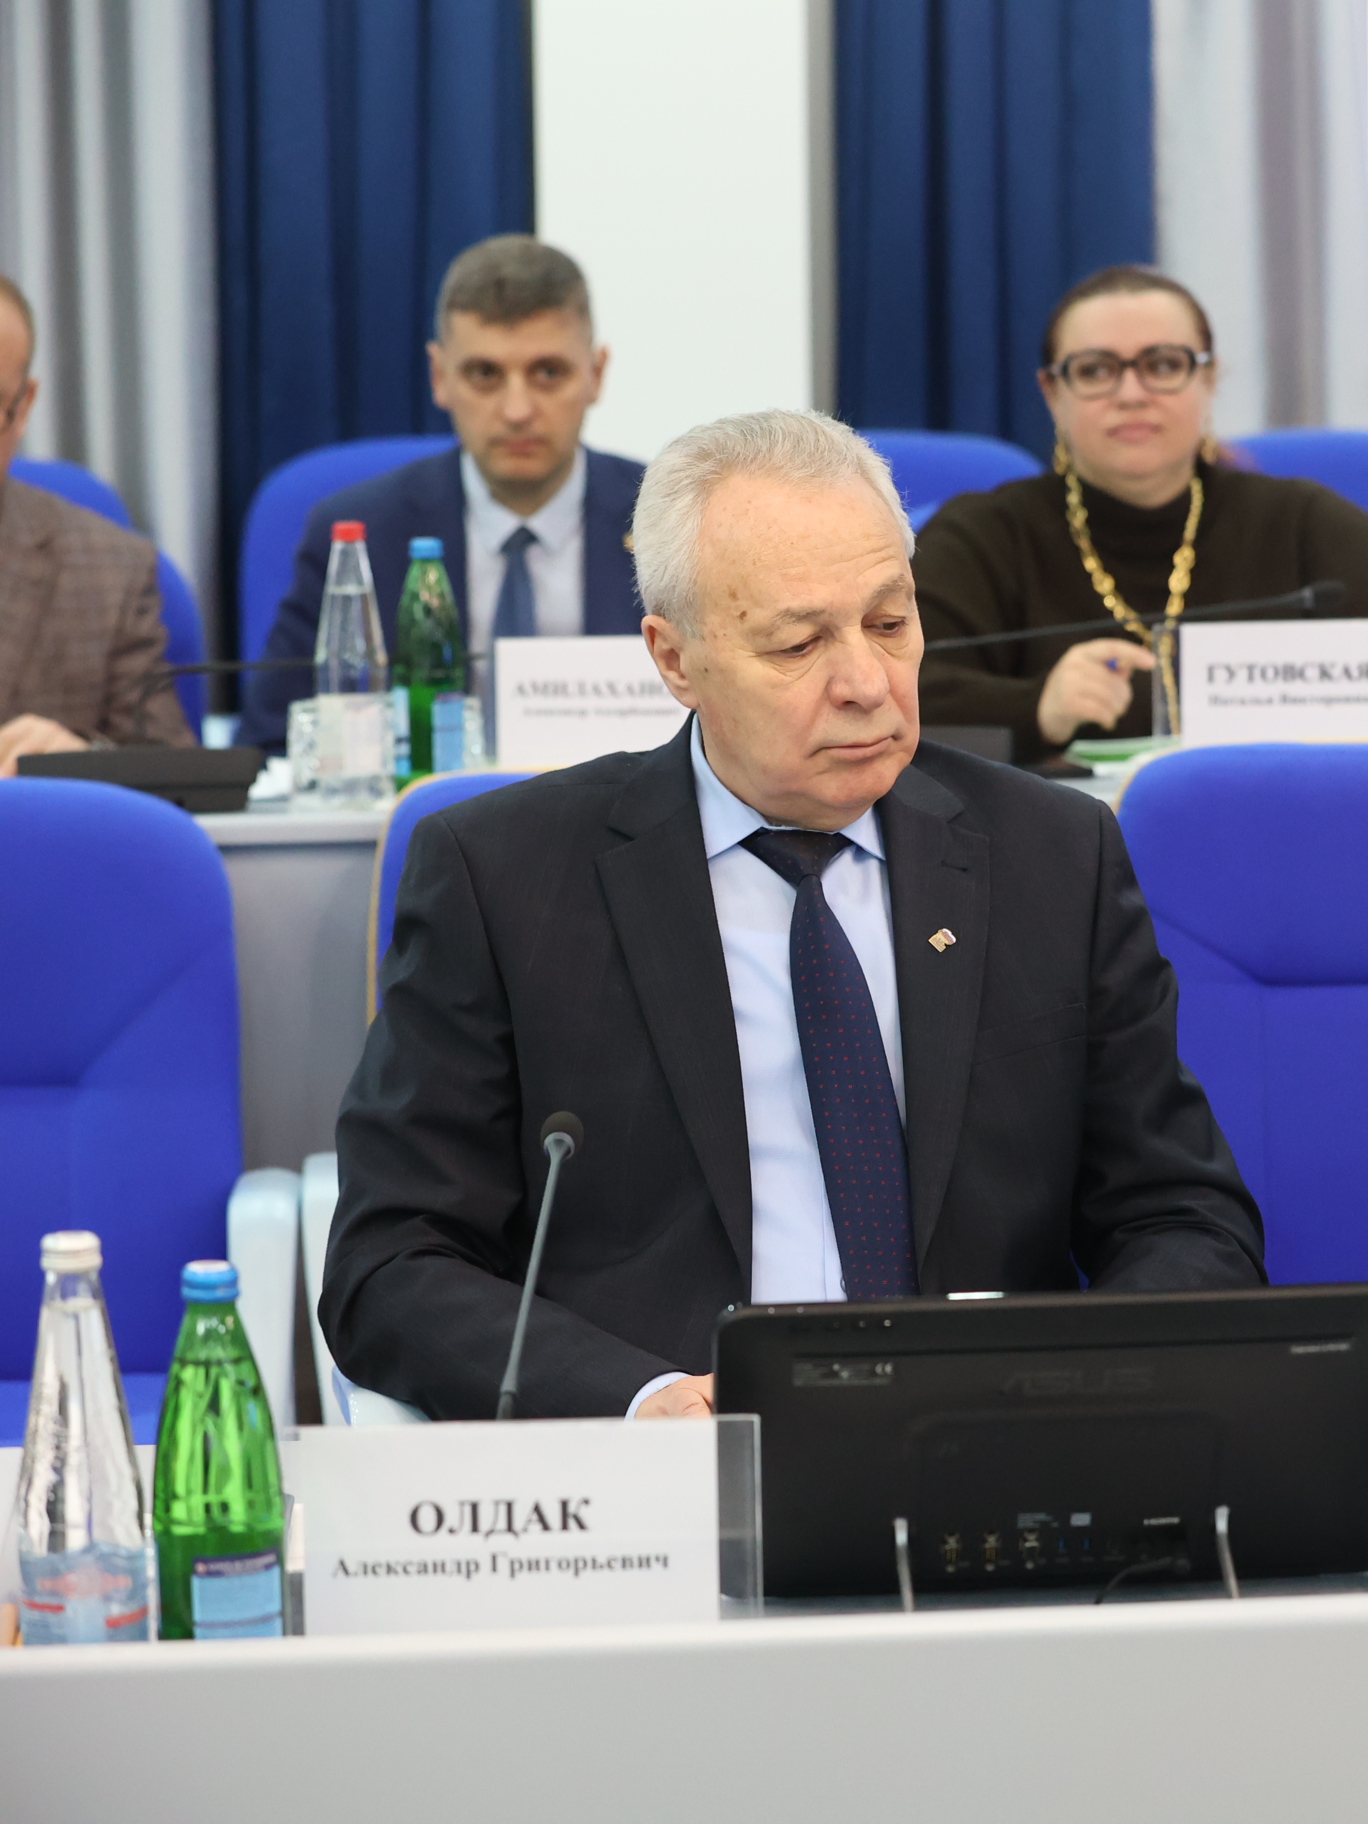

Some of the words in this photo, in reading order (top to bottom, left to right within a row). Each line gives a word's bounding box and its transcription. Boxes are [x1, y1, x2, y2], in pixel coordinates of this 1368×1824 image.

[409, 1497, 592, 1540] ОЛДАК
[332, 1556, 479, 1580] Александр
[489, 1551, 670, 1579] Григорьевич
